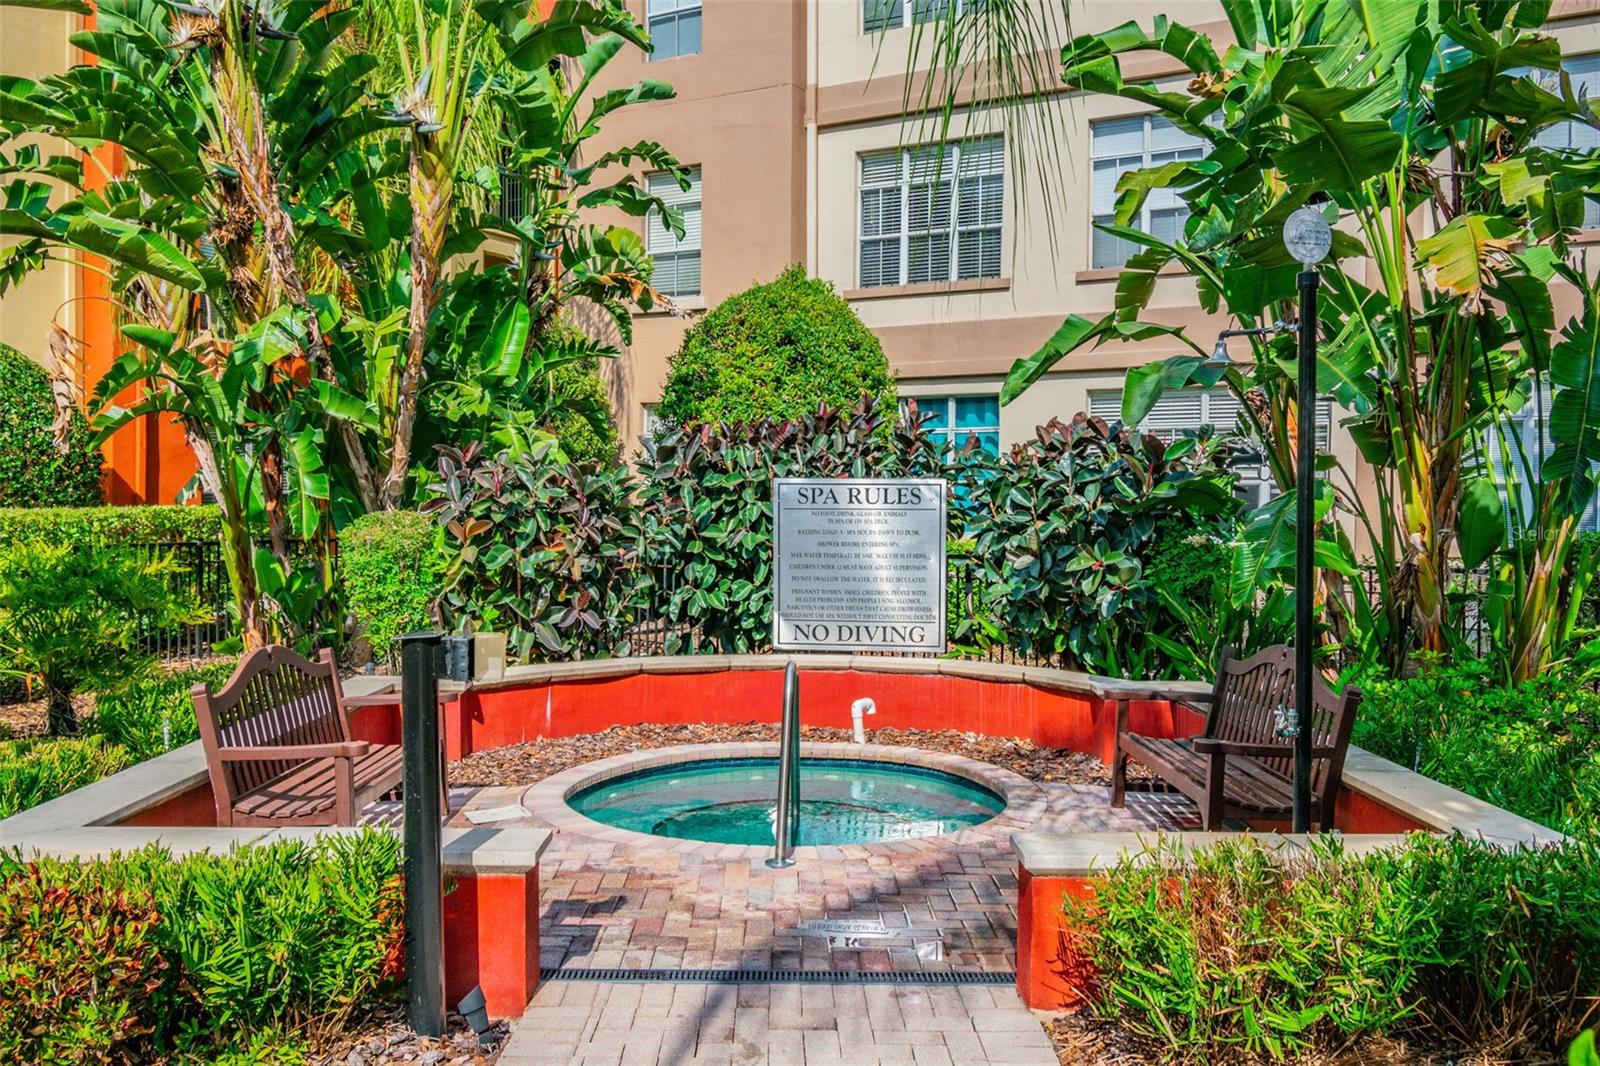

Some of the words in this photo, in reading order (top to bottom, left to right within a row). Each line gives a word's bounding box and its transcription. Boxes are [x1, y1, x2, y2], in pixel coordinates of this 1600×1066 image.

[797, 487, 840, 505] SPA
[847, 487, 922, 505] RULES
[793, 624, 830, 641] NO
[837, 625, 926, 643] DIVING
